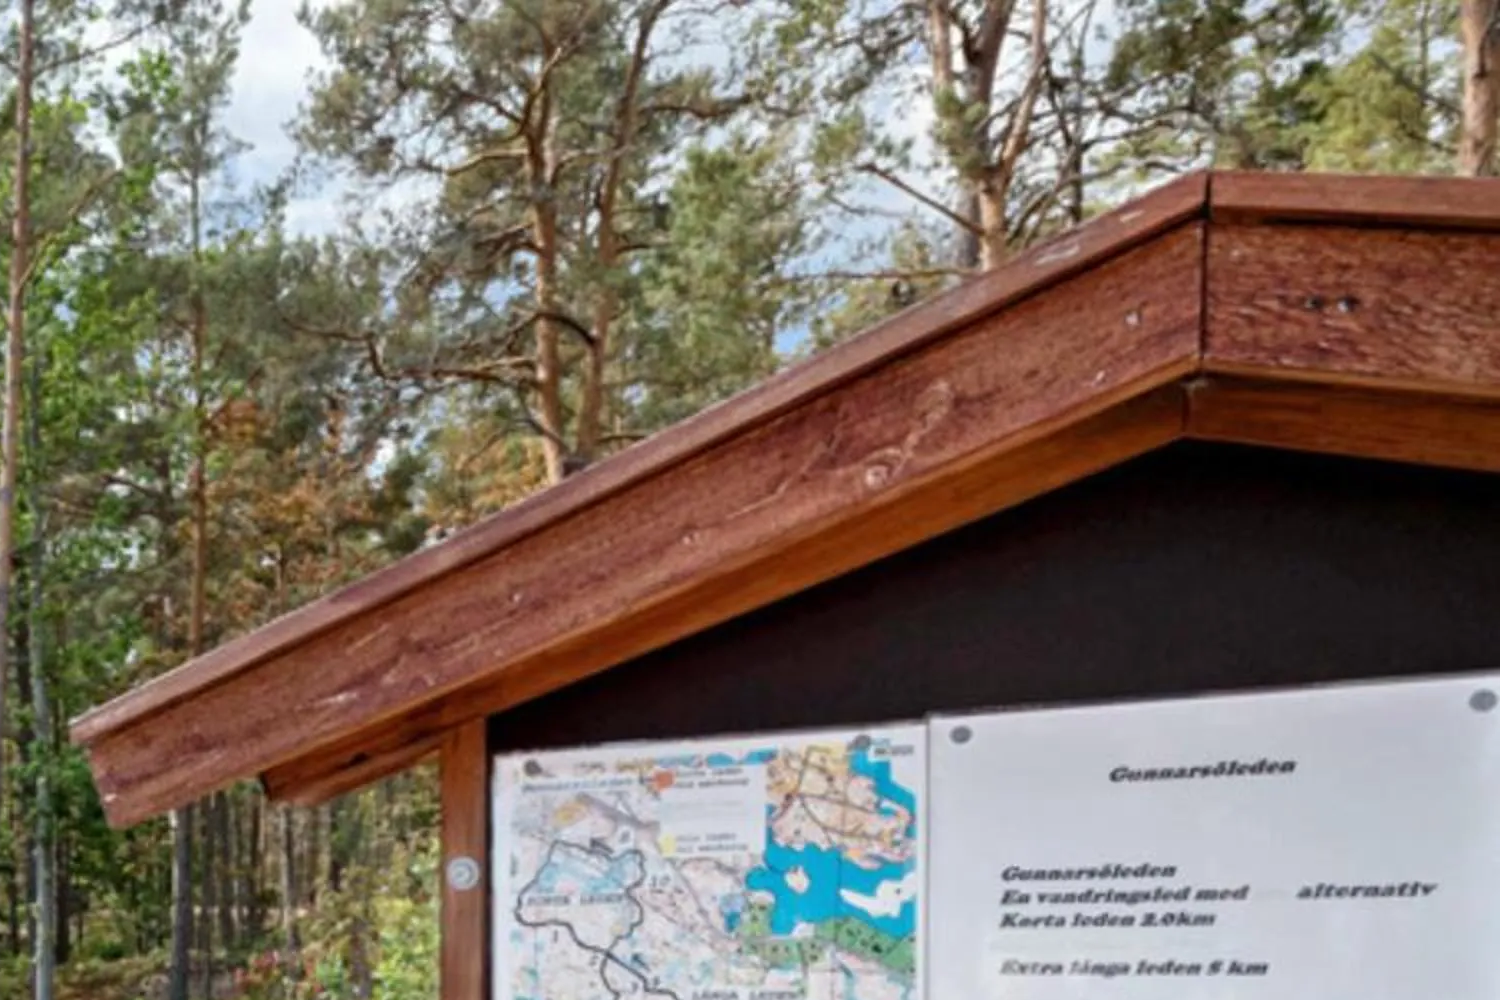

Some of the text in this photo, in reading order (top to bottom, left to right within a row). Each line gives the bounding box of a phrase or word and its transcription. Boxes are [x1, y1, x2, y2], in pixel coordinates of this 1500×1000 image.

[1109, 760, 1297, 782] Gunnarsöleden
[1001, 864, 1176, 882] Gunnarsöleden
[1001, 881, 1437, 906] En vandringsled med alternativ
[1000, 911, 1066, 928] Korta
[1071, 911, 1134, 927] leden
[1136, 959, 1201, 975] leden
[1227, 959, 1269, 975] km
